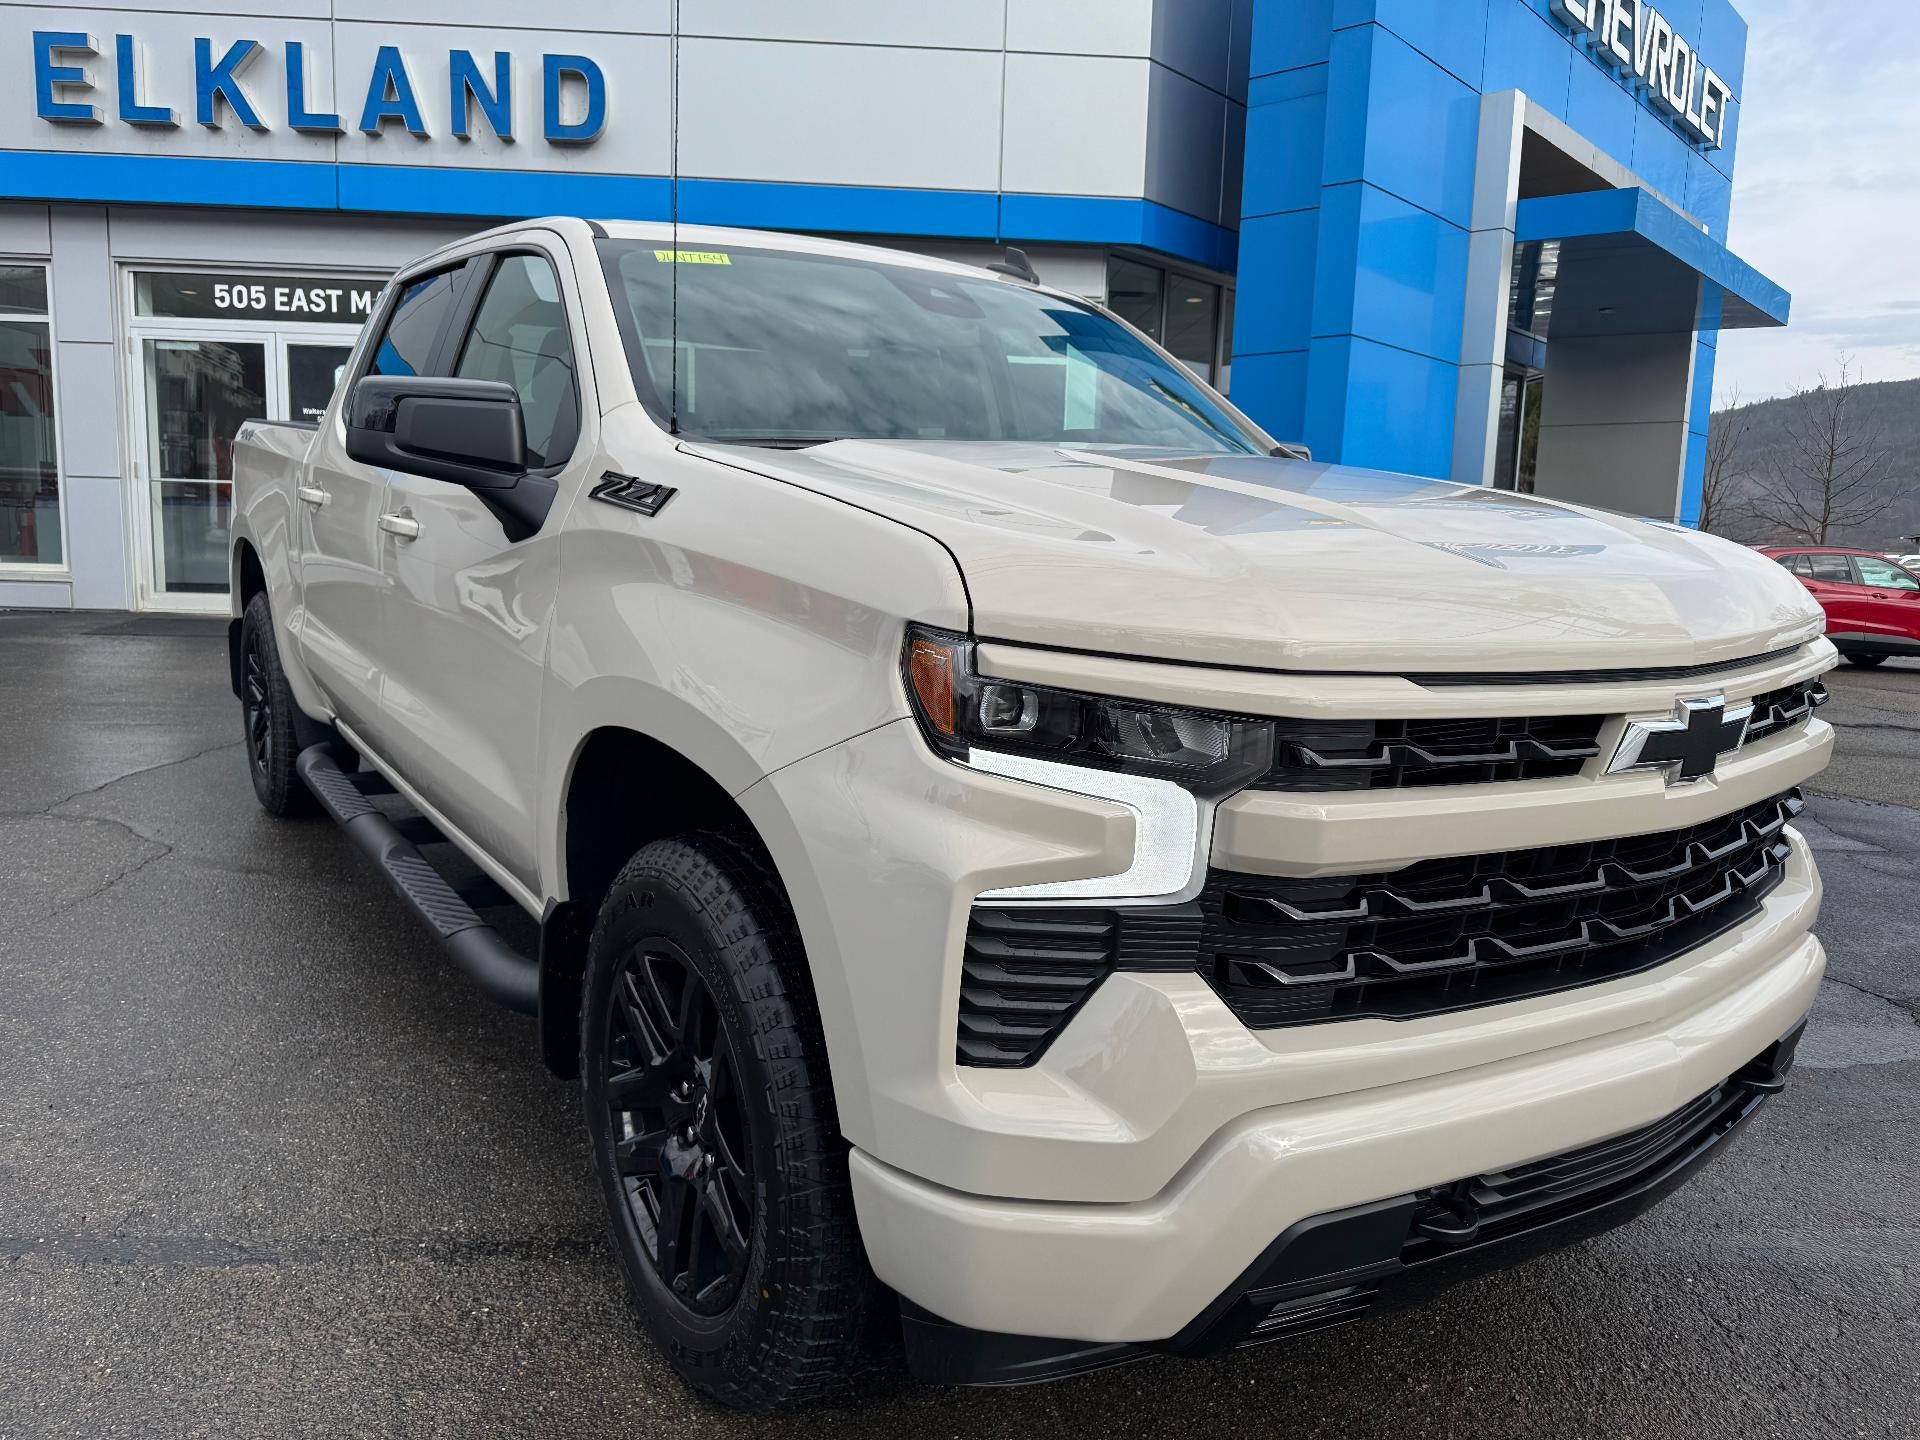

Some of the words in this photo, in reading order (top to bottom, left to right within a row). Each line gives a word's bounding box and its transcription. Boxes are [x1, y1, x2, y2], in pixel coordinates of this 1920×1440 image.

[33, 31, 608, 143] ELKLAND
[214, 284, 266, 309] 505
[274, 287, 343, 313] EAST
